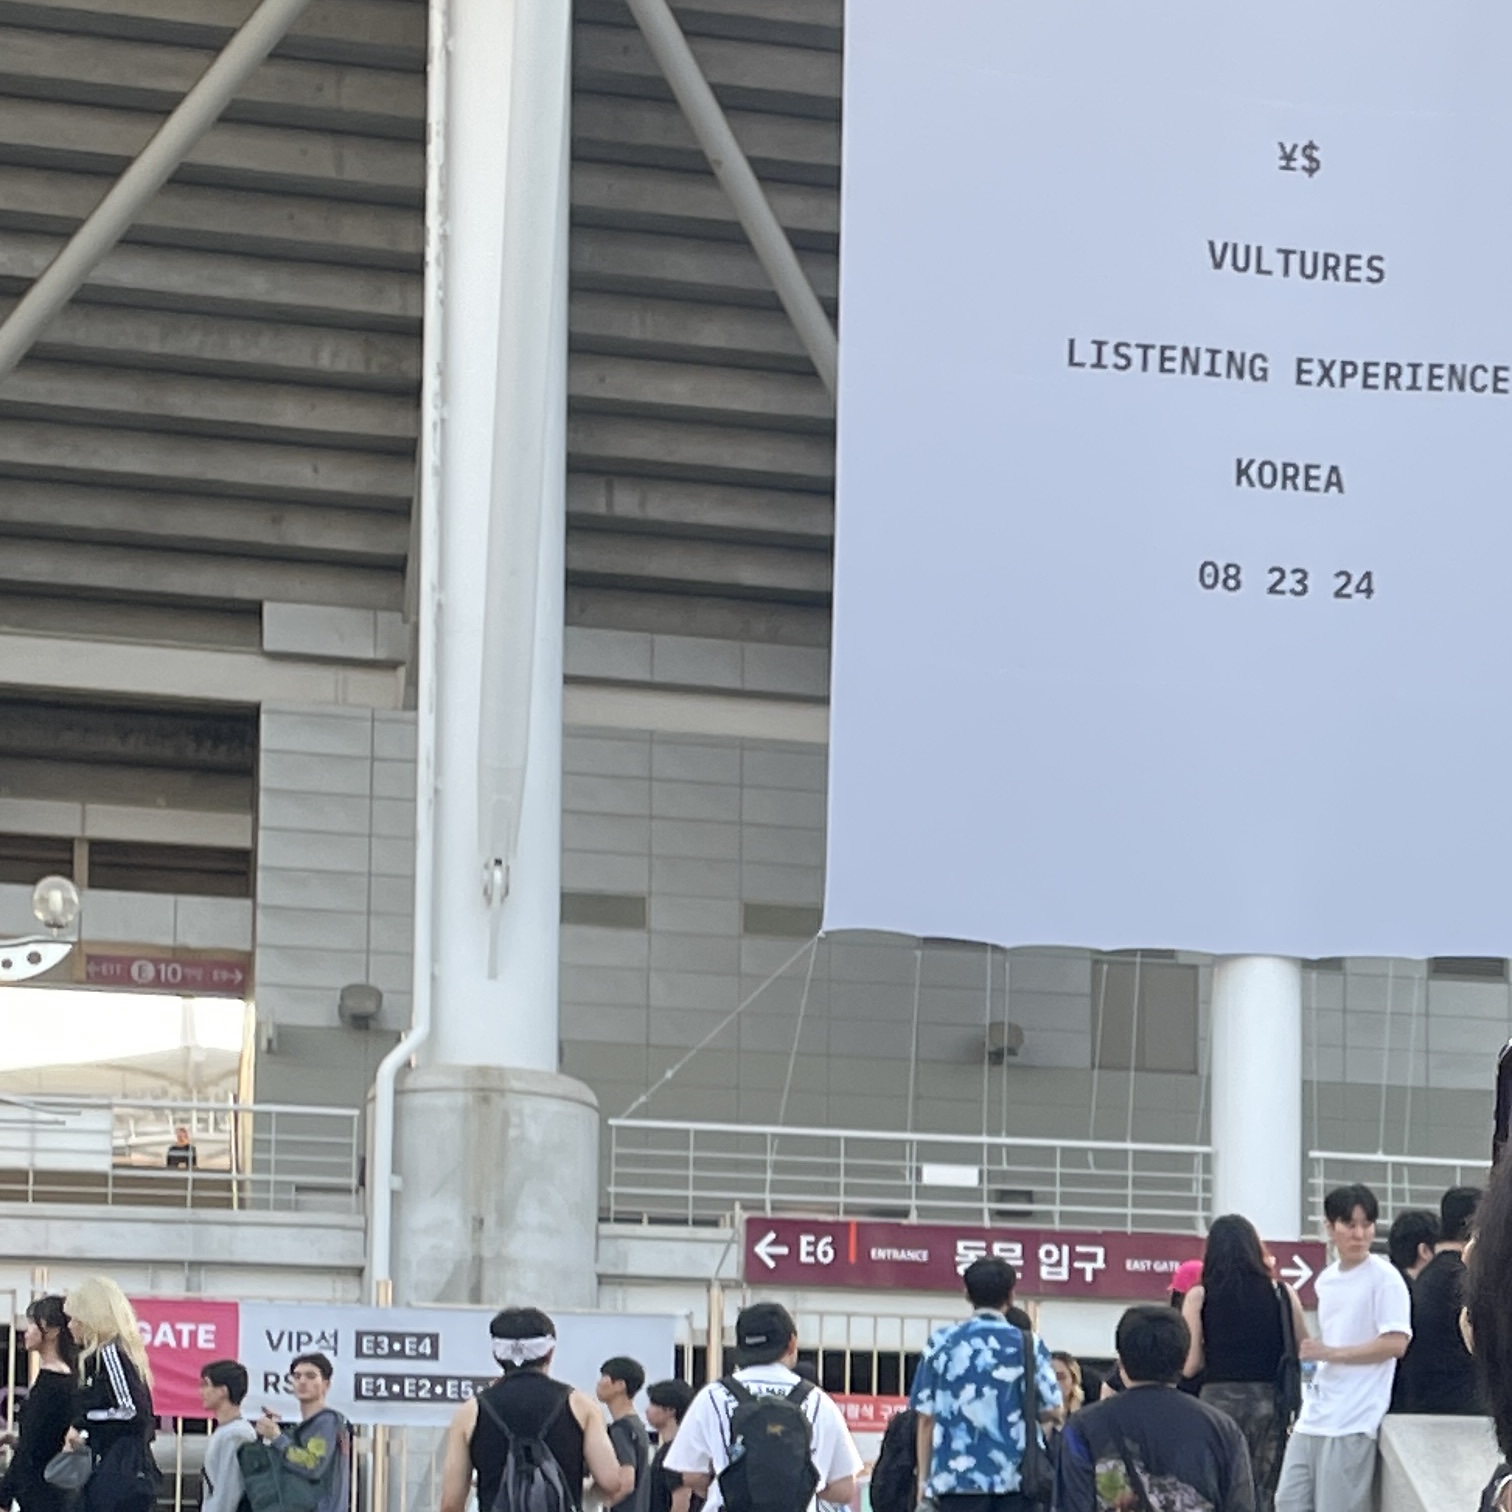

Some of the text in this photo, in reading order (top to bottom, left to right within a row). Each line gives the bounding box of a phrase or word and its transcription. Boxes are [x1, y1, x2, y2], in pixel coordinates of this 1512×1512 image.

[1277, 139, 1321, 177] ¥$
[1207, 239, 1387, 285] VULTURES
[1066, 337, 1511, 395] LISTENING EXPERIENCE
[1234, 457, 1346, 495] KOREA
[1198, 560, 1376, 600] 08 23 24
[799, 1233, 835, 1265] E6
[869, 1246, 930, 1264] ENTRANCE
[1037, 1242, 1106, 1283] 입구
[1124, 1258, 1151, 1272] EAST
